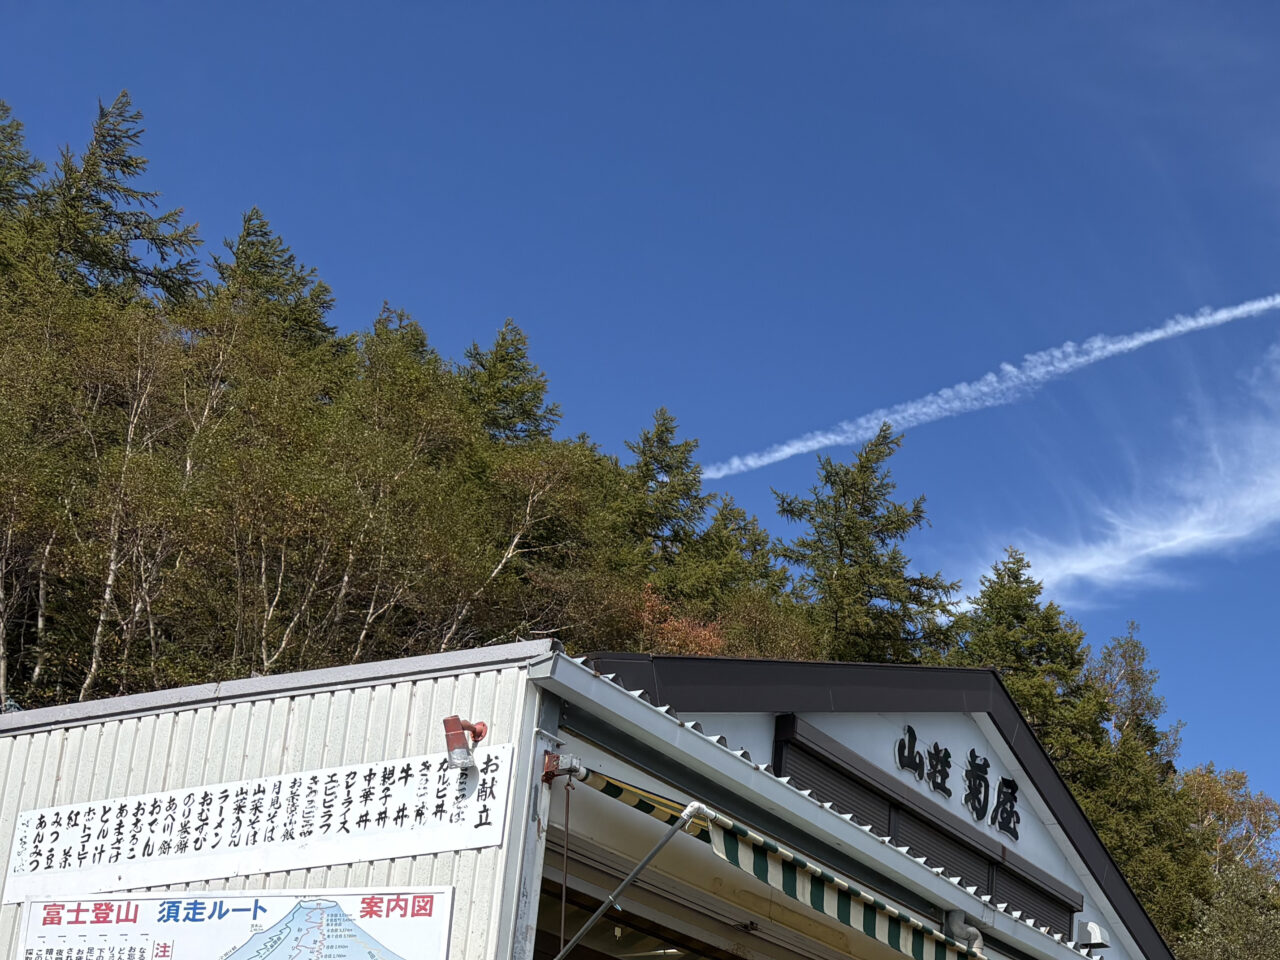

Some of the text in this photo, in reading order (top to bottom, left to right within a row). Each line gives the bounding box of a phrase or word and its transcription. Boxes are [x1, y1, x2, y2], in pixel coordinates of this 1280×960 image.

[263, 781, 282, 842] 月見そば
[319, 773, 339, 834] エビピラフ
[337, 771, 357, 833] カレーライス
[356, 768, 377, 830] 中華丼
[375, 766, 396, 828] 親子丼
[393, 763, 414, 827] 牛丼
[432, 758, 450, 821] カルビ丼
[474, 754, 500, 829] お献立
[895, 725, 1020, 841] 山荘菊屋
[29, 814, 47, 872] あんみつ
[44, 812, 62, 870] みつ豆
[59, 810, 80, 869] 紅茶
[92, 806, 111, 864] とん汁
[142, 798, 161, 857] おでん
[193, 791, 213, 850] おむすび
[211, 789, 230, 849] ラーメン
[245, 784, 266, 846] 山菜そば
[42, 894, 434, 926] 富士登山 須走ルート 案内図
